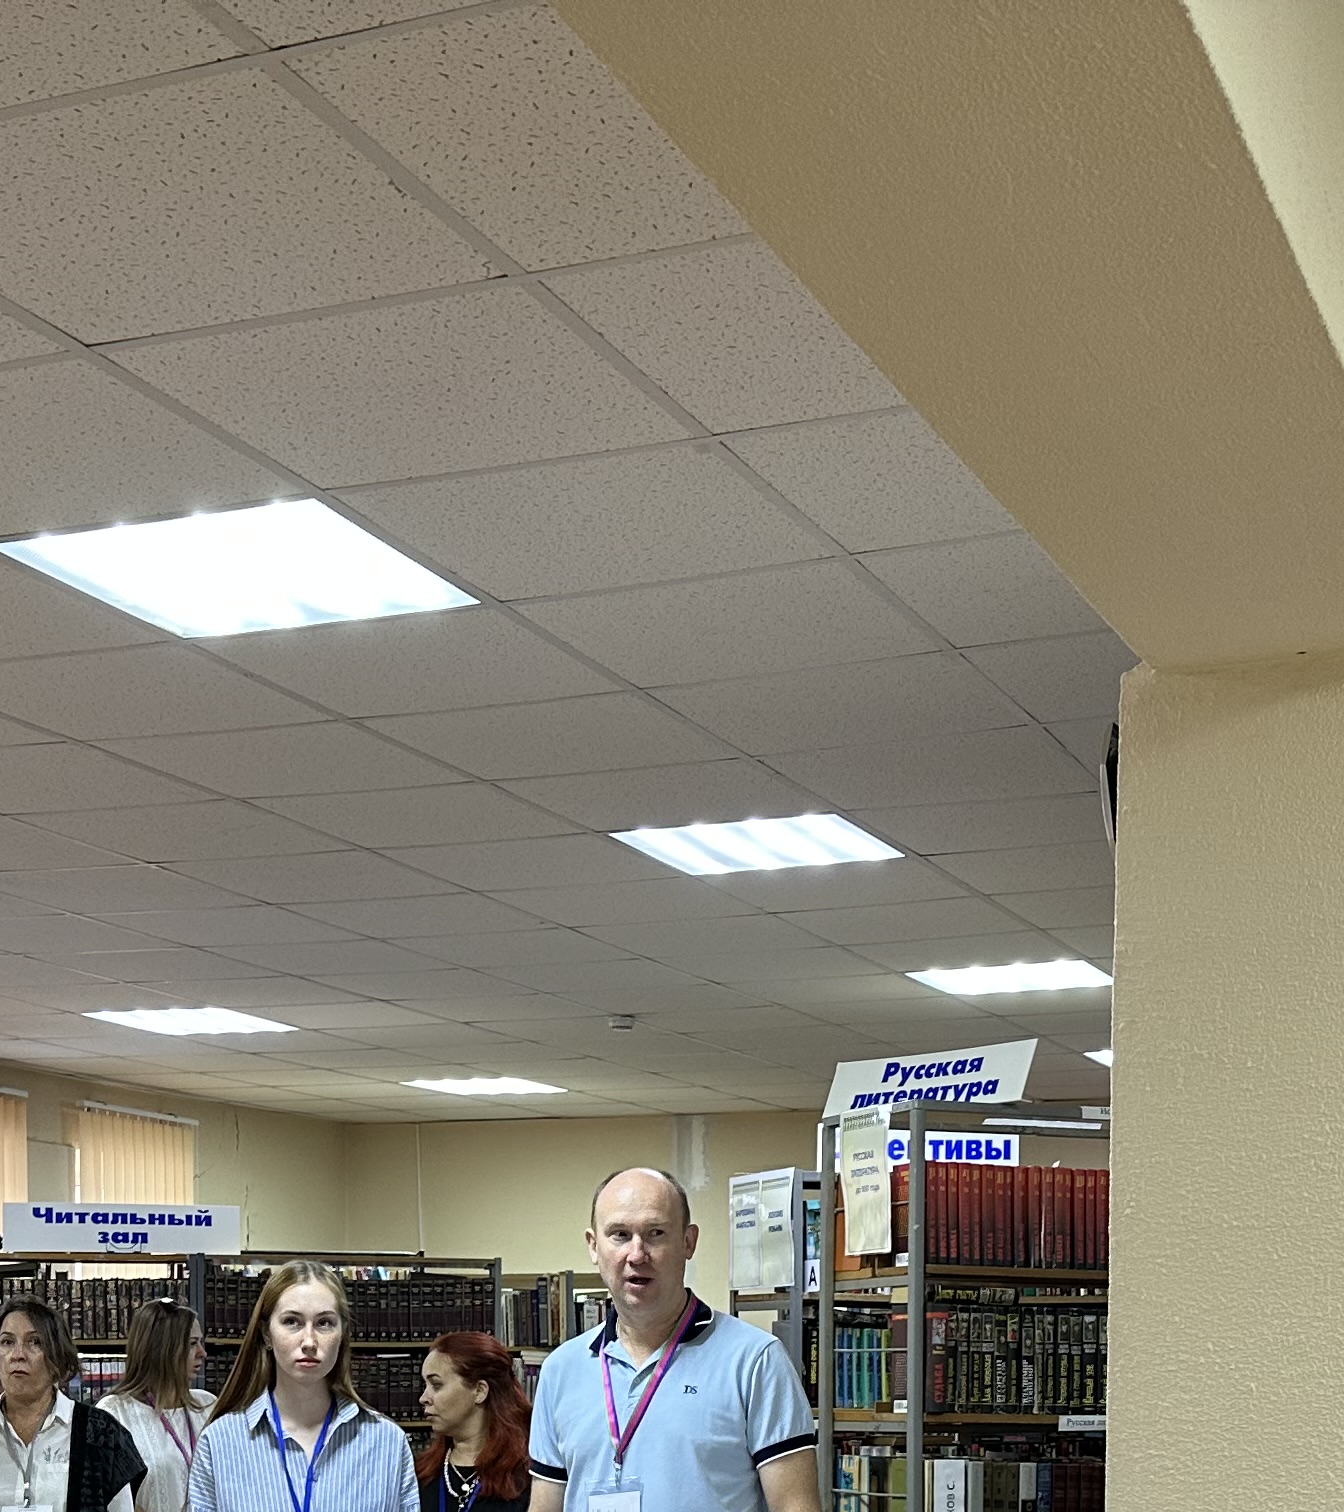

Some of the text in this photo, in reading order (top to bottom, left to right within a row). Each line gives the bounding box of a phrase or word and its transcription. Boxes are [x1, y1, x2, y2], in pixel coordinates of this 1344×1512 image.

[881, 1056, 984, 1087] Русская
[849, 1078, 1000, 1109] литература
[32, 1207, 213, 1227] Читальный
[98, 1231, 149, 1245] зал
[809, 1265, 818, 1287] А
